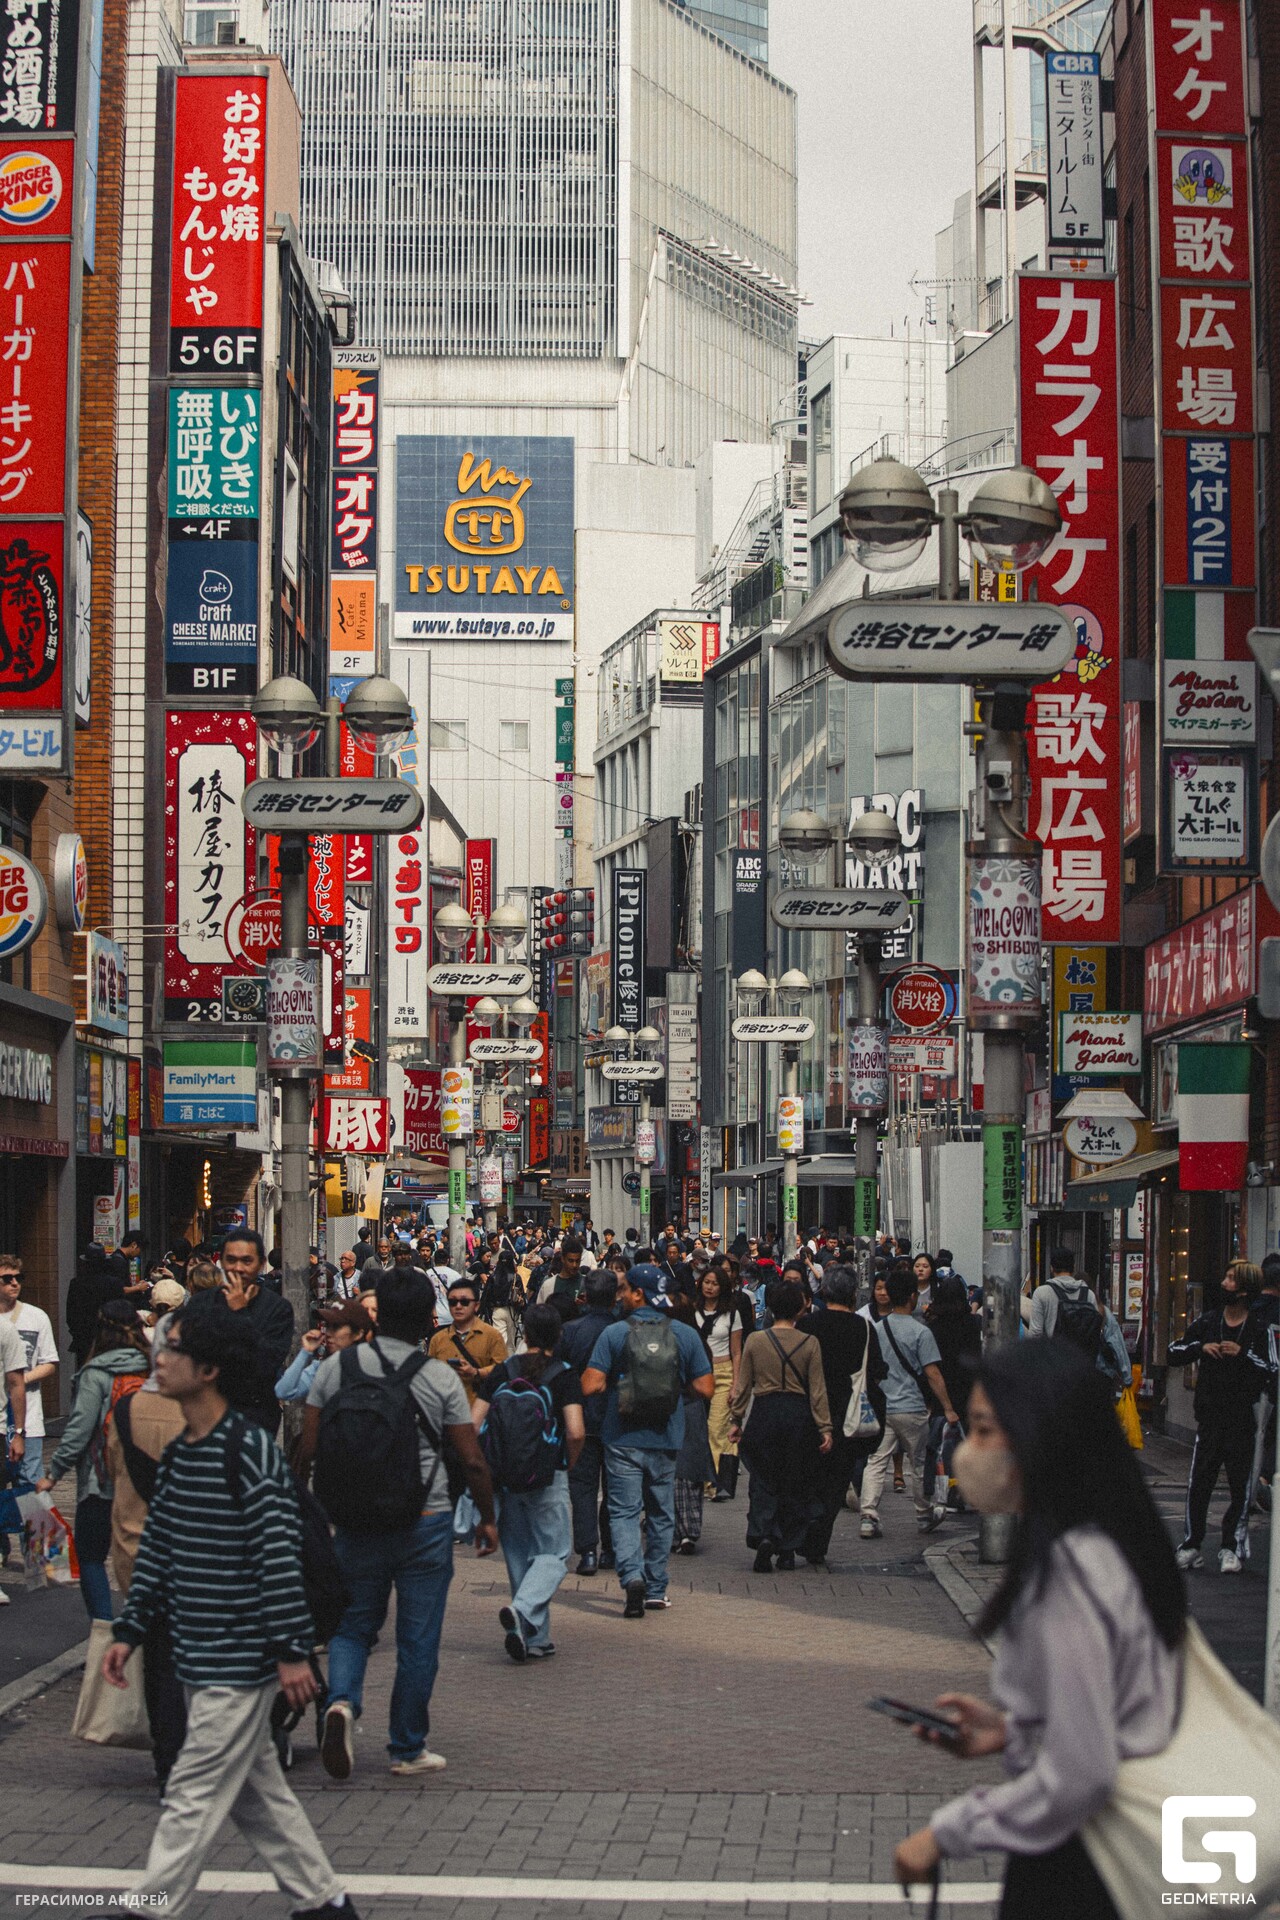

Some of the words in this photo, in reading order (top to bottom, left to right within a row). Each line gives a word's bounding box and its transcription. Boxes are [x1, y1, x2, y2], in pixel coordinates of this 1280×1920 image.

[1052, 55, 1093, 73] CBR
[1170, 9, 1227, 121] オケ
[1079, 80, 1094, 166] 渋谷センター街
[1055, 79, 1077, 215] モニタールーム
[220, 90, 261, 242] お好み焼
[0, 177, 53, 206] KING
[1065, 223, 1089, 236] 5F
[180, 166, 218, 315] もんじゃ
[337, 352, 377, 363] プリンスビル
[0, 258, 39, 500] バーガーキング
[176, 390, 214, 500] 無呼吸
[219, 390, 258, 499] いびき
[336, 389, 375, 549] カラオケ
[175, 503, 255, 516] ご相談ください
[1190, 442, 1228, 581] 受付2F
[201, 520, 231, 539] 4F
[342, 549, 363, 562] Ban
[348, 555, 369, 568] Ban
[204, 582, 227, 593] craft
[405, 565, 565, 595] TSUTAYA
[199, 604, 232, 622] Craft
[346, 603, 355, 627] Cafe
[357, 591, 367, 640] Miyama
[173, 623, 208, 636] CHEESE
[210, 623, 257, 641] MARKET
[412, 618, 555, 637] www.tsutaya.co.jp
[843, 622, 1061, 651] 渋谷センター街
[344, 657, 360, 668] 2F
[667, 658, 698, 669] ソレイユ
[193, 668, 236, 688] B1F
[1168, 671, 1239, 691] Miami
[1168, 718, 1252, 731] マイアミガーデン
[1183, 780, 1237, 793] 大衆食堂
[252, 793, 411, 814] 渋谷センター街
[1188, 796, 1231, 814] てんぐ
[1178, 814, 1241, 834] 大ホール
[187, 769, 236, 940] 椿屋カフェ
[736, 857, 762, 870] ABC
[314, 834, 334, 922] 地もんじゃ
[471, 858, 484, 886] BIG
[736, 870, 762, 879] MART
[845, 852, 921, 890] MART
[248, 909, 263, 917] FIRE
[264, 909, 281, 917] HYDR
[472, 888, 484, 921] ECH
[780, 900, 902, 917] 渋谷センター街
[973, 906, 1039, 938] WELCOME
[244, 921, 281, 946] 消火
[618, 874, 640, 1023] iPhone修理
[846, 938, 909, 961] SGE
[987, 940, 1040, 954] SHIBUYA
[1147, 896, 1250, 1028] カラオケ歌広場
[433, 973, 526, 986] 渋谷センター街
[897, 989, 942, 1012] 消火栓
[242, 1013, 257, 1021] 80m
[274, 1014, 317, 1025] SHIBUYA
[397, 1006, 415, 1015] 渋谷
[394, 1016, 420, 1026] 2号店
[737, 1023, 810, 1033] 渋谷センター街
[1065, 1030, 1126, 1047] Miami
[473, 1045, 538, 1055] 渋谷センター街
[25, 1048, 52, 1105] KING
[169, 1073, 236, 1087] FamilyMart
[605, 1066, 660, 1075] 渋谷センター街
[1069, 1075, 1090, 1084] 24h
[442, 1095, 472, 1105] Welcome
[180, 1105, 194, 1120] 酒
[198, 1106, 225, 1119] たばこ
[327, 1098, 382, 1150] 豚
[405, 1130, 428, 1151] BIG
[430, 1133, 450, 1151] ECH
[1080, 1138, 1122, 1151] 大ホール
